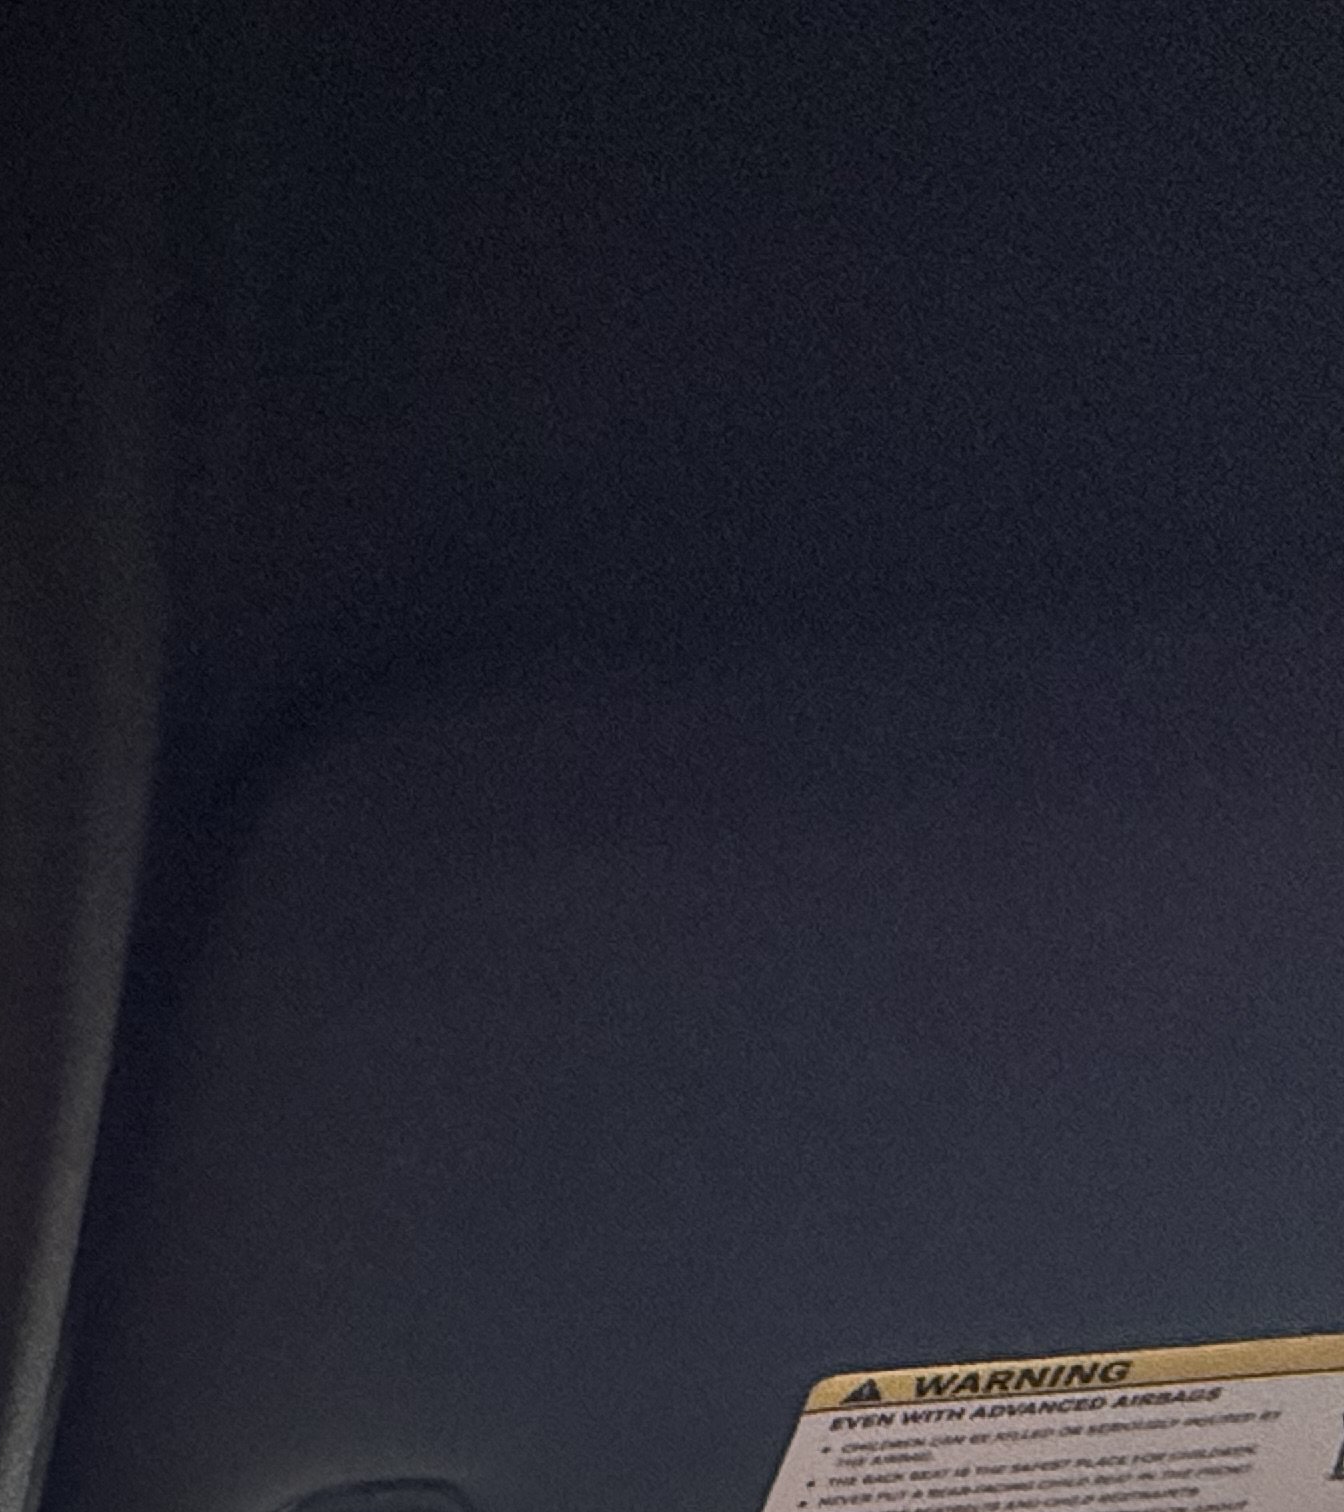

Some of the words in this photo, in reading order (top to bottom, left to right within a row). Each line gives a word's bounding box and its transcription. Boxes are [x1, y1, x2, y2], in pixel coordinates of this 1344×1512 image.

[915, 1360, 1132, 1397] WARNING
[828, 1412, 895, 1431] EVEN
[900, 1406, 966, 1426] WITH
[969, 1395, 1108, 1420] ADVANCED
[1111, 1386, 1222, 1409] AIRBAGS
